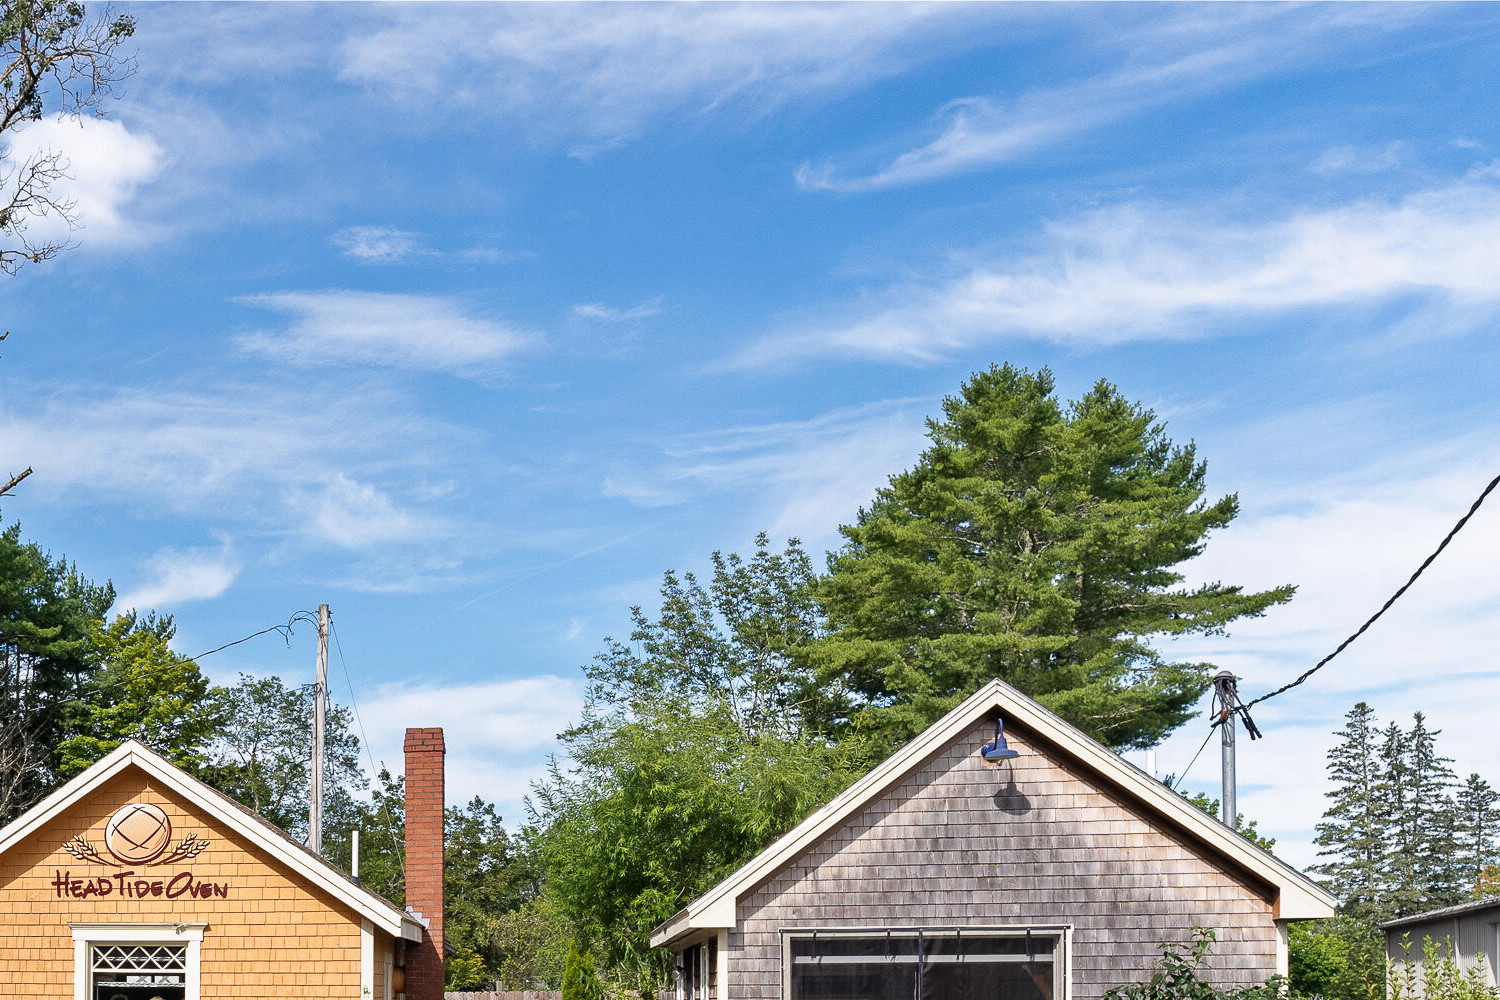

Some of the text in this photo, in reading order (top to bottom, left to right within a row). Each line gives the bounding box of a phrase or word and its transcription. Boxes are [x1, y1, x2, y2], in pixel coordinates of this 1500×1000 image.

[51, 870, 228, 898] HEAD TIDE OVEN
